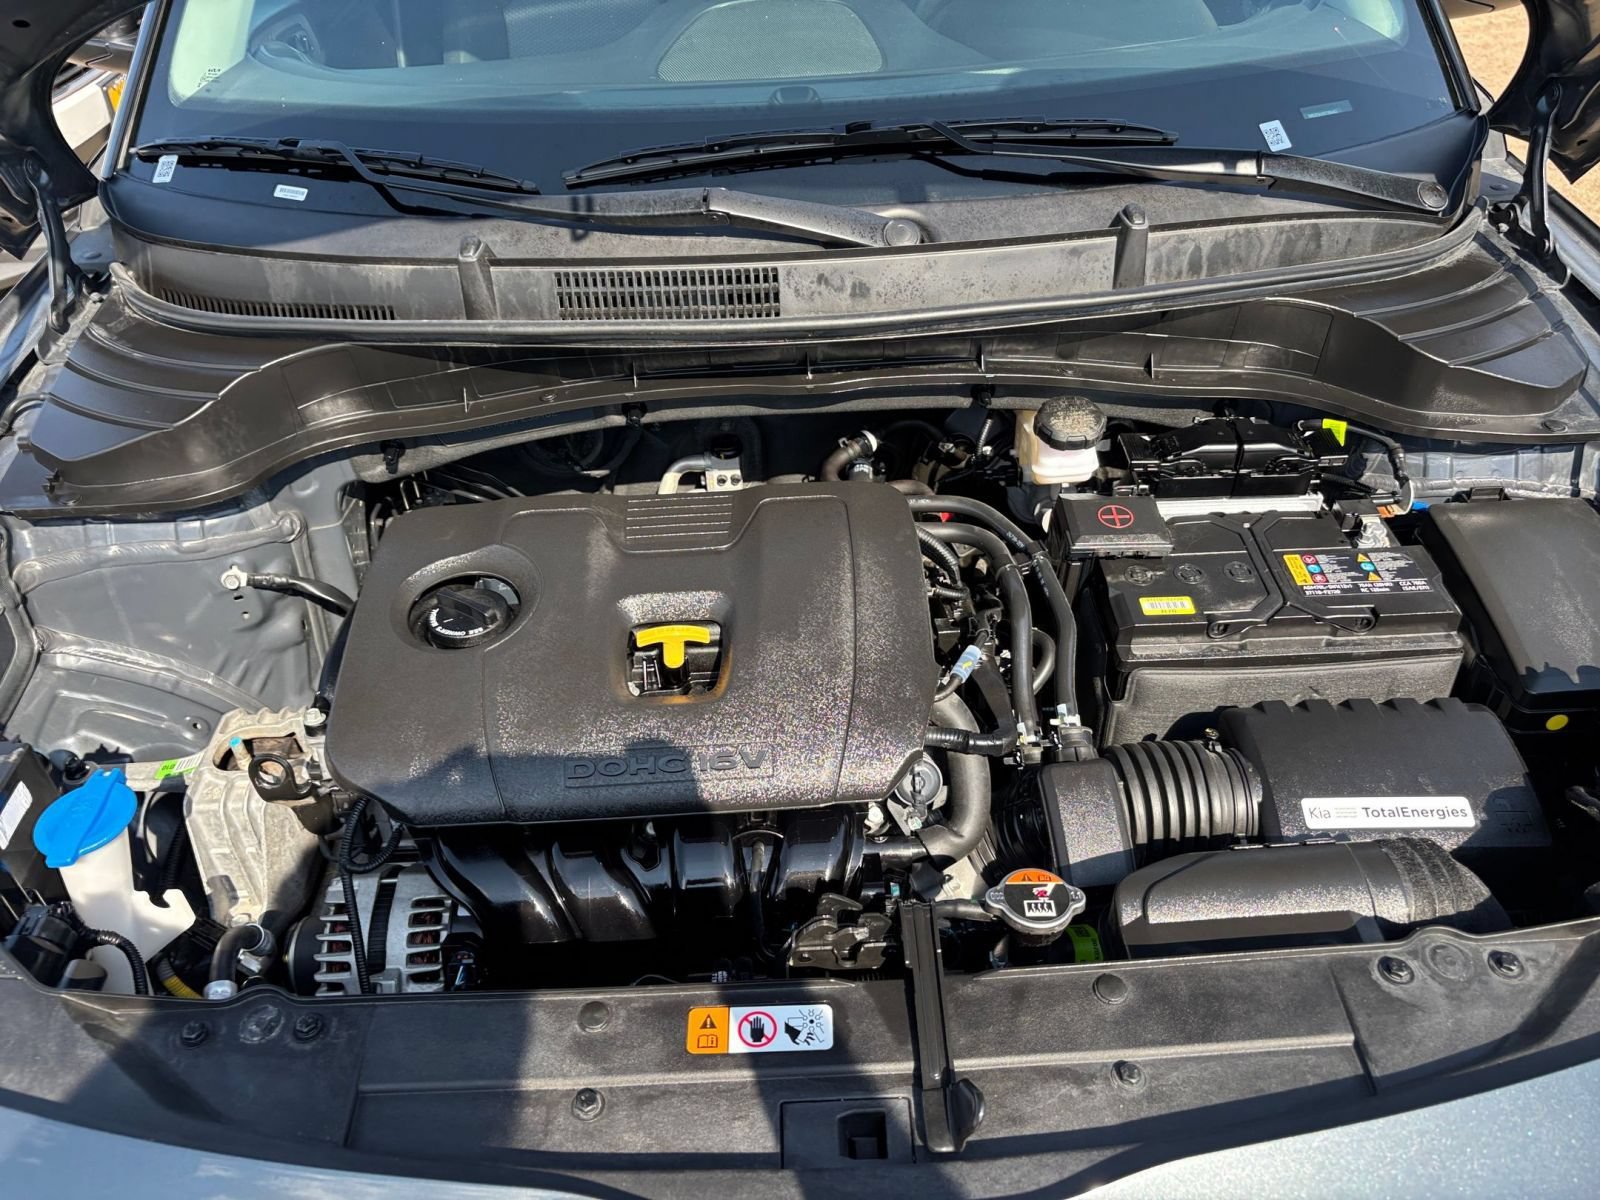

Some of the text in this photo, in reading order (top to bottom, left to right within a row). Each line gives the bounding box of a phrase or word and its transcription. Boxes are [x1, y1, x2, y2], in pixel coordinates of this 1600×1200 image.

[566, 745, 768, 780] DOHC 16V
[1308, 806, 1468, 820] Kia TotalEnergies
